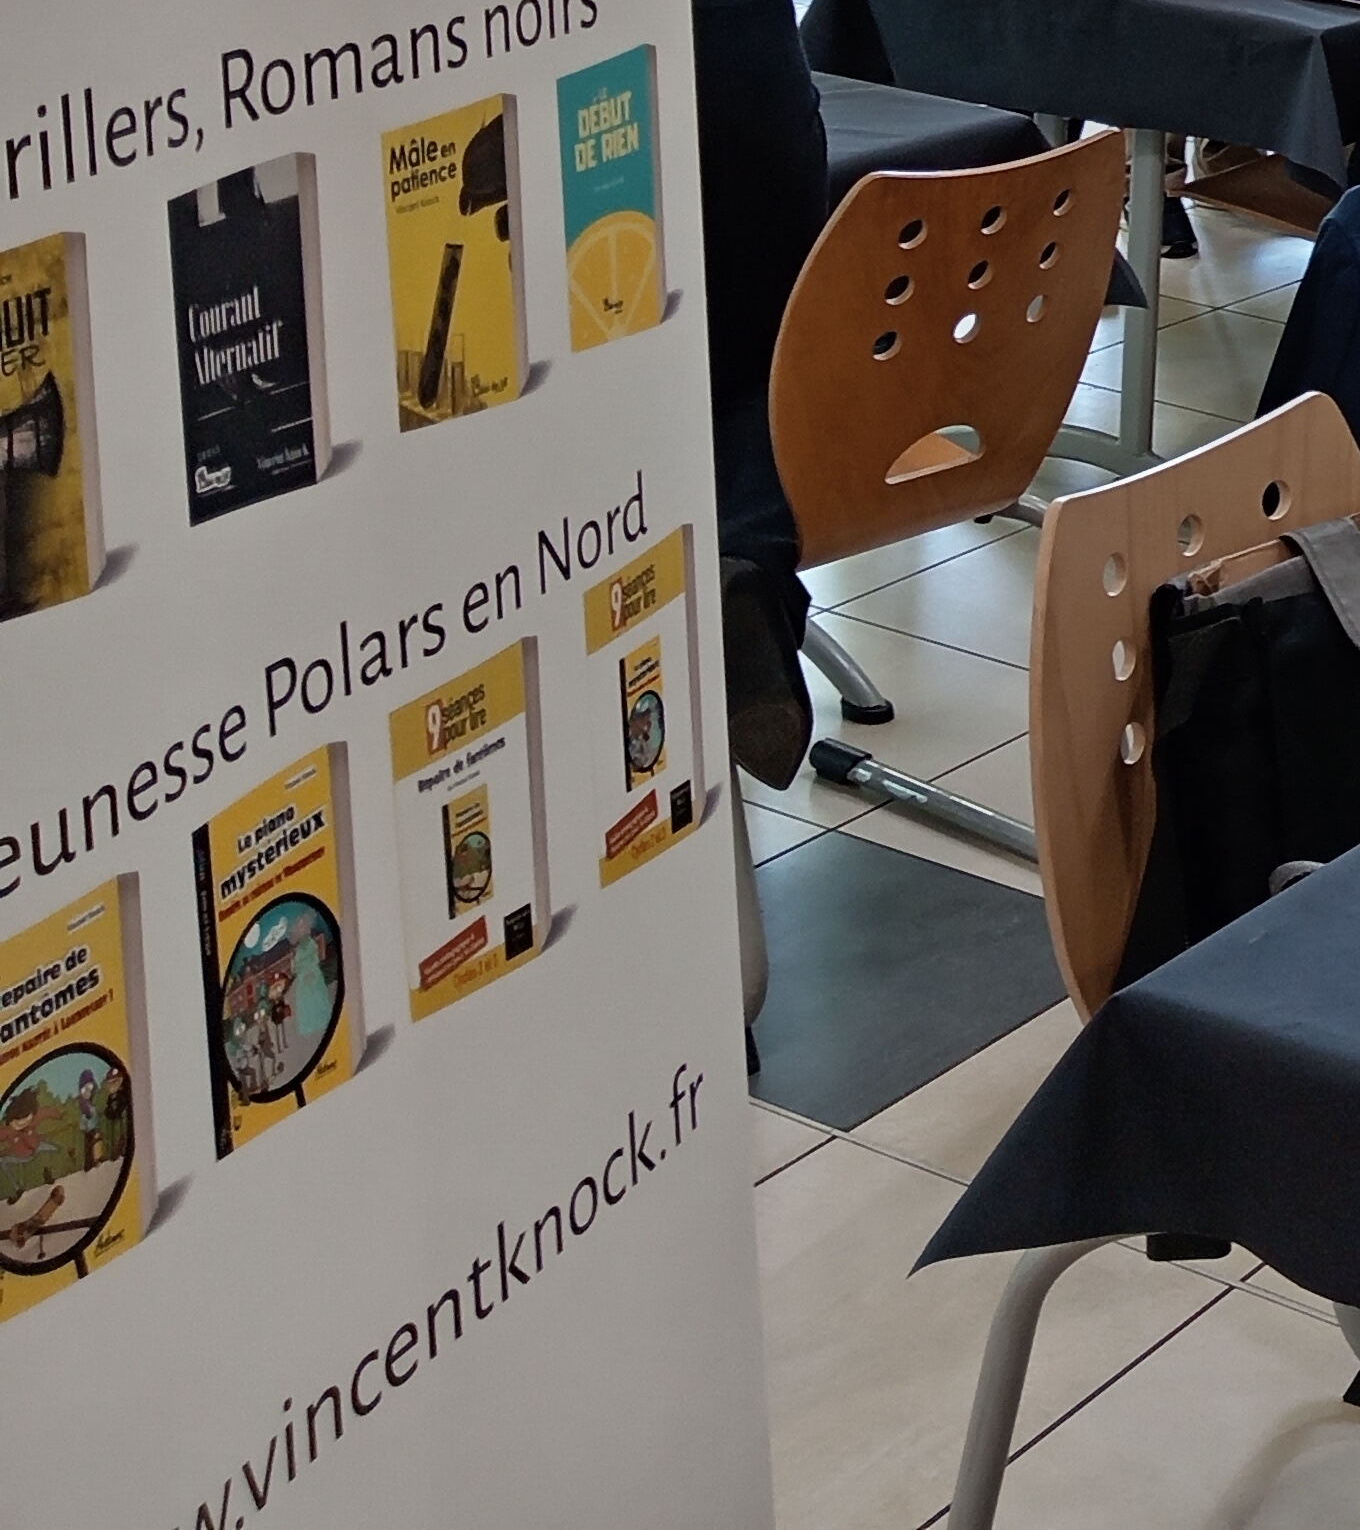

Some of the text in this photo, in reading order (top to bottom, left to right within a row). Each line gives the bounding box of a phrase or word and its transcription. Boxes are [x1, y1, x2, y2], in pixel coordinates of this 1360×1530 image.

[220, 13, 469, 130] Romans
[389, 136, 457, 175] Mâle en
[574, 122, 640, 173] DE RIEN
[390, 162, 458, 204] patience
[0, 285, 52, 349] UIT
[188, 284, 262, 343] Courant
[263, 608, 446, 722] Polars
[462, 564, 521, 636] en
[537, 470, 649, 596] Nord
[236, 806, 295, 854] Le piano
[64, 946, 88, 972] de
